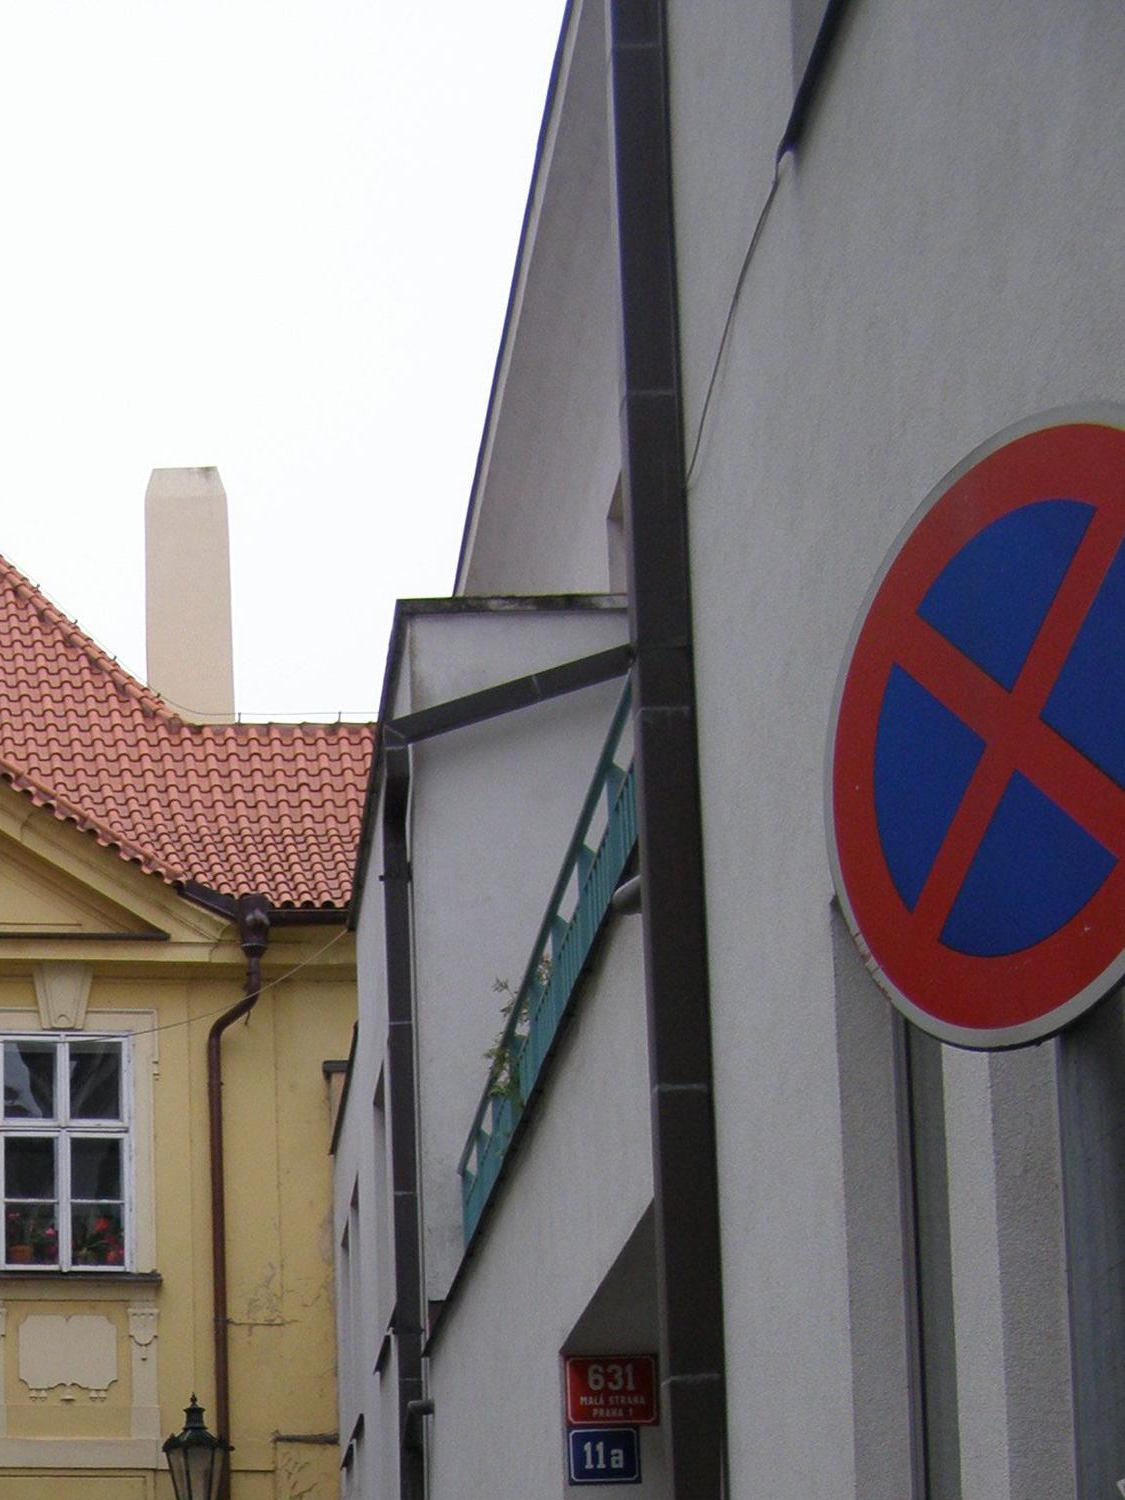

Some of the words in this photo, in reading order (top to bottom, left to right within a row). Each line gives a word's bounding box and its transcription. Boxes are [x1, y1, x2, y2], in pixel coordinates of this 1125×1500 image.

[587, 1363, 635, 1391] 631
[579, 1393, 604, 1405] MALÁ
[609, 1395, 645, 1405] STRANA
[592, 1408, 624, 1417] PRAHA
[583, 1441, 624, 1469] 11a
